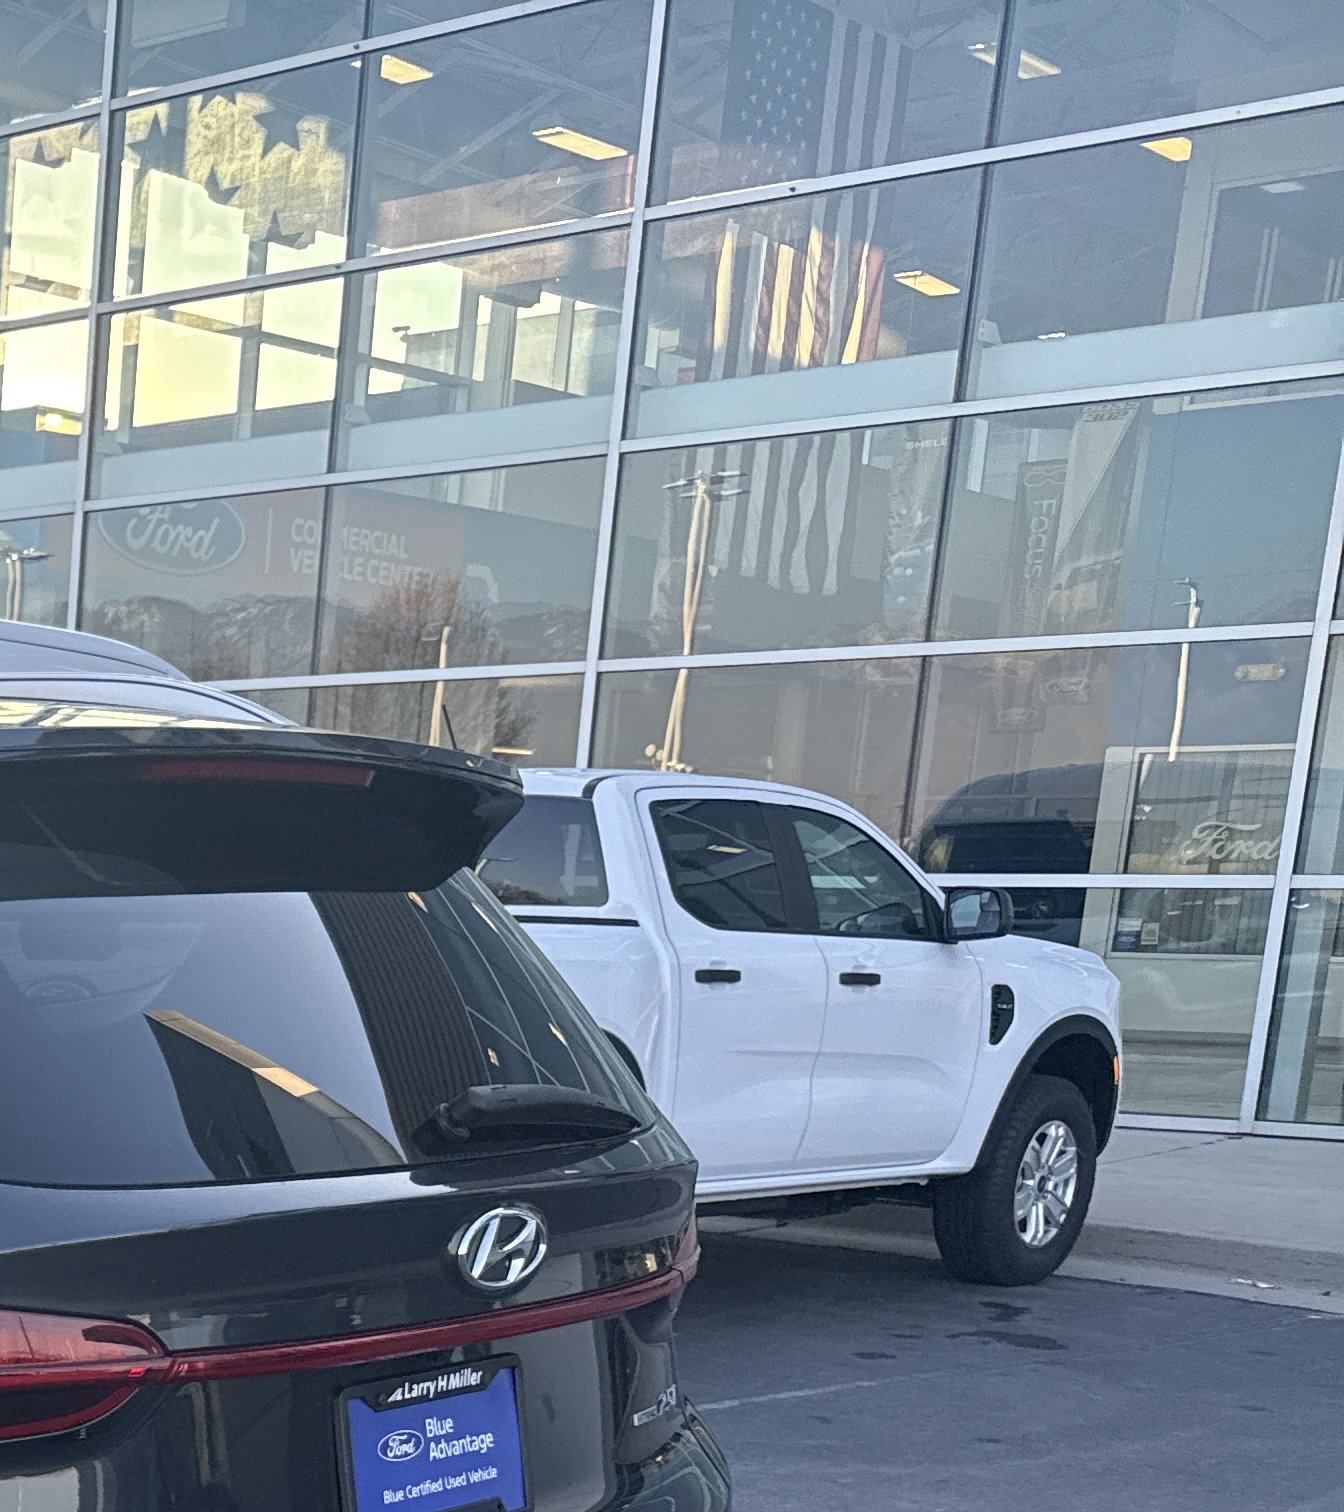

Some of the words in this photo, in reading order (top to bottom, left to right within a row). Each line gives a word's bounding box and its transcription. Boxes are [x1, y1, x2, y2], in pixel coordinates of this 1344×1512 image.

[291, 517, 410, 559] COERCIAL
[289, 548, 364, 581] VELE
[1179, 820, 1281, 864] Ford
[404, 1380, 436, 1398] Larry
[438, 1374, 448, 1392] H
[448, 1368, 483, 1390] Miller
[424, 1417, 454, 1437] Blue
[386, 1434, 416, 1458] Ford
[429, 1431, 495, 1461] Advantage
[383, 1488, 405, 1504] Blue
[406, 1477, 443, 1499] Certified
[444, 1472, 466, 1489] Used
[467, 1466, 498, 1484] Vehicle
